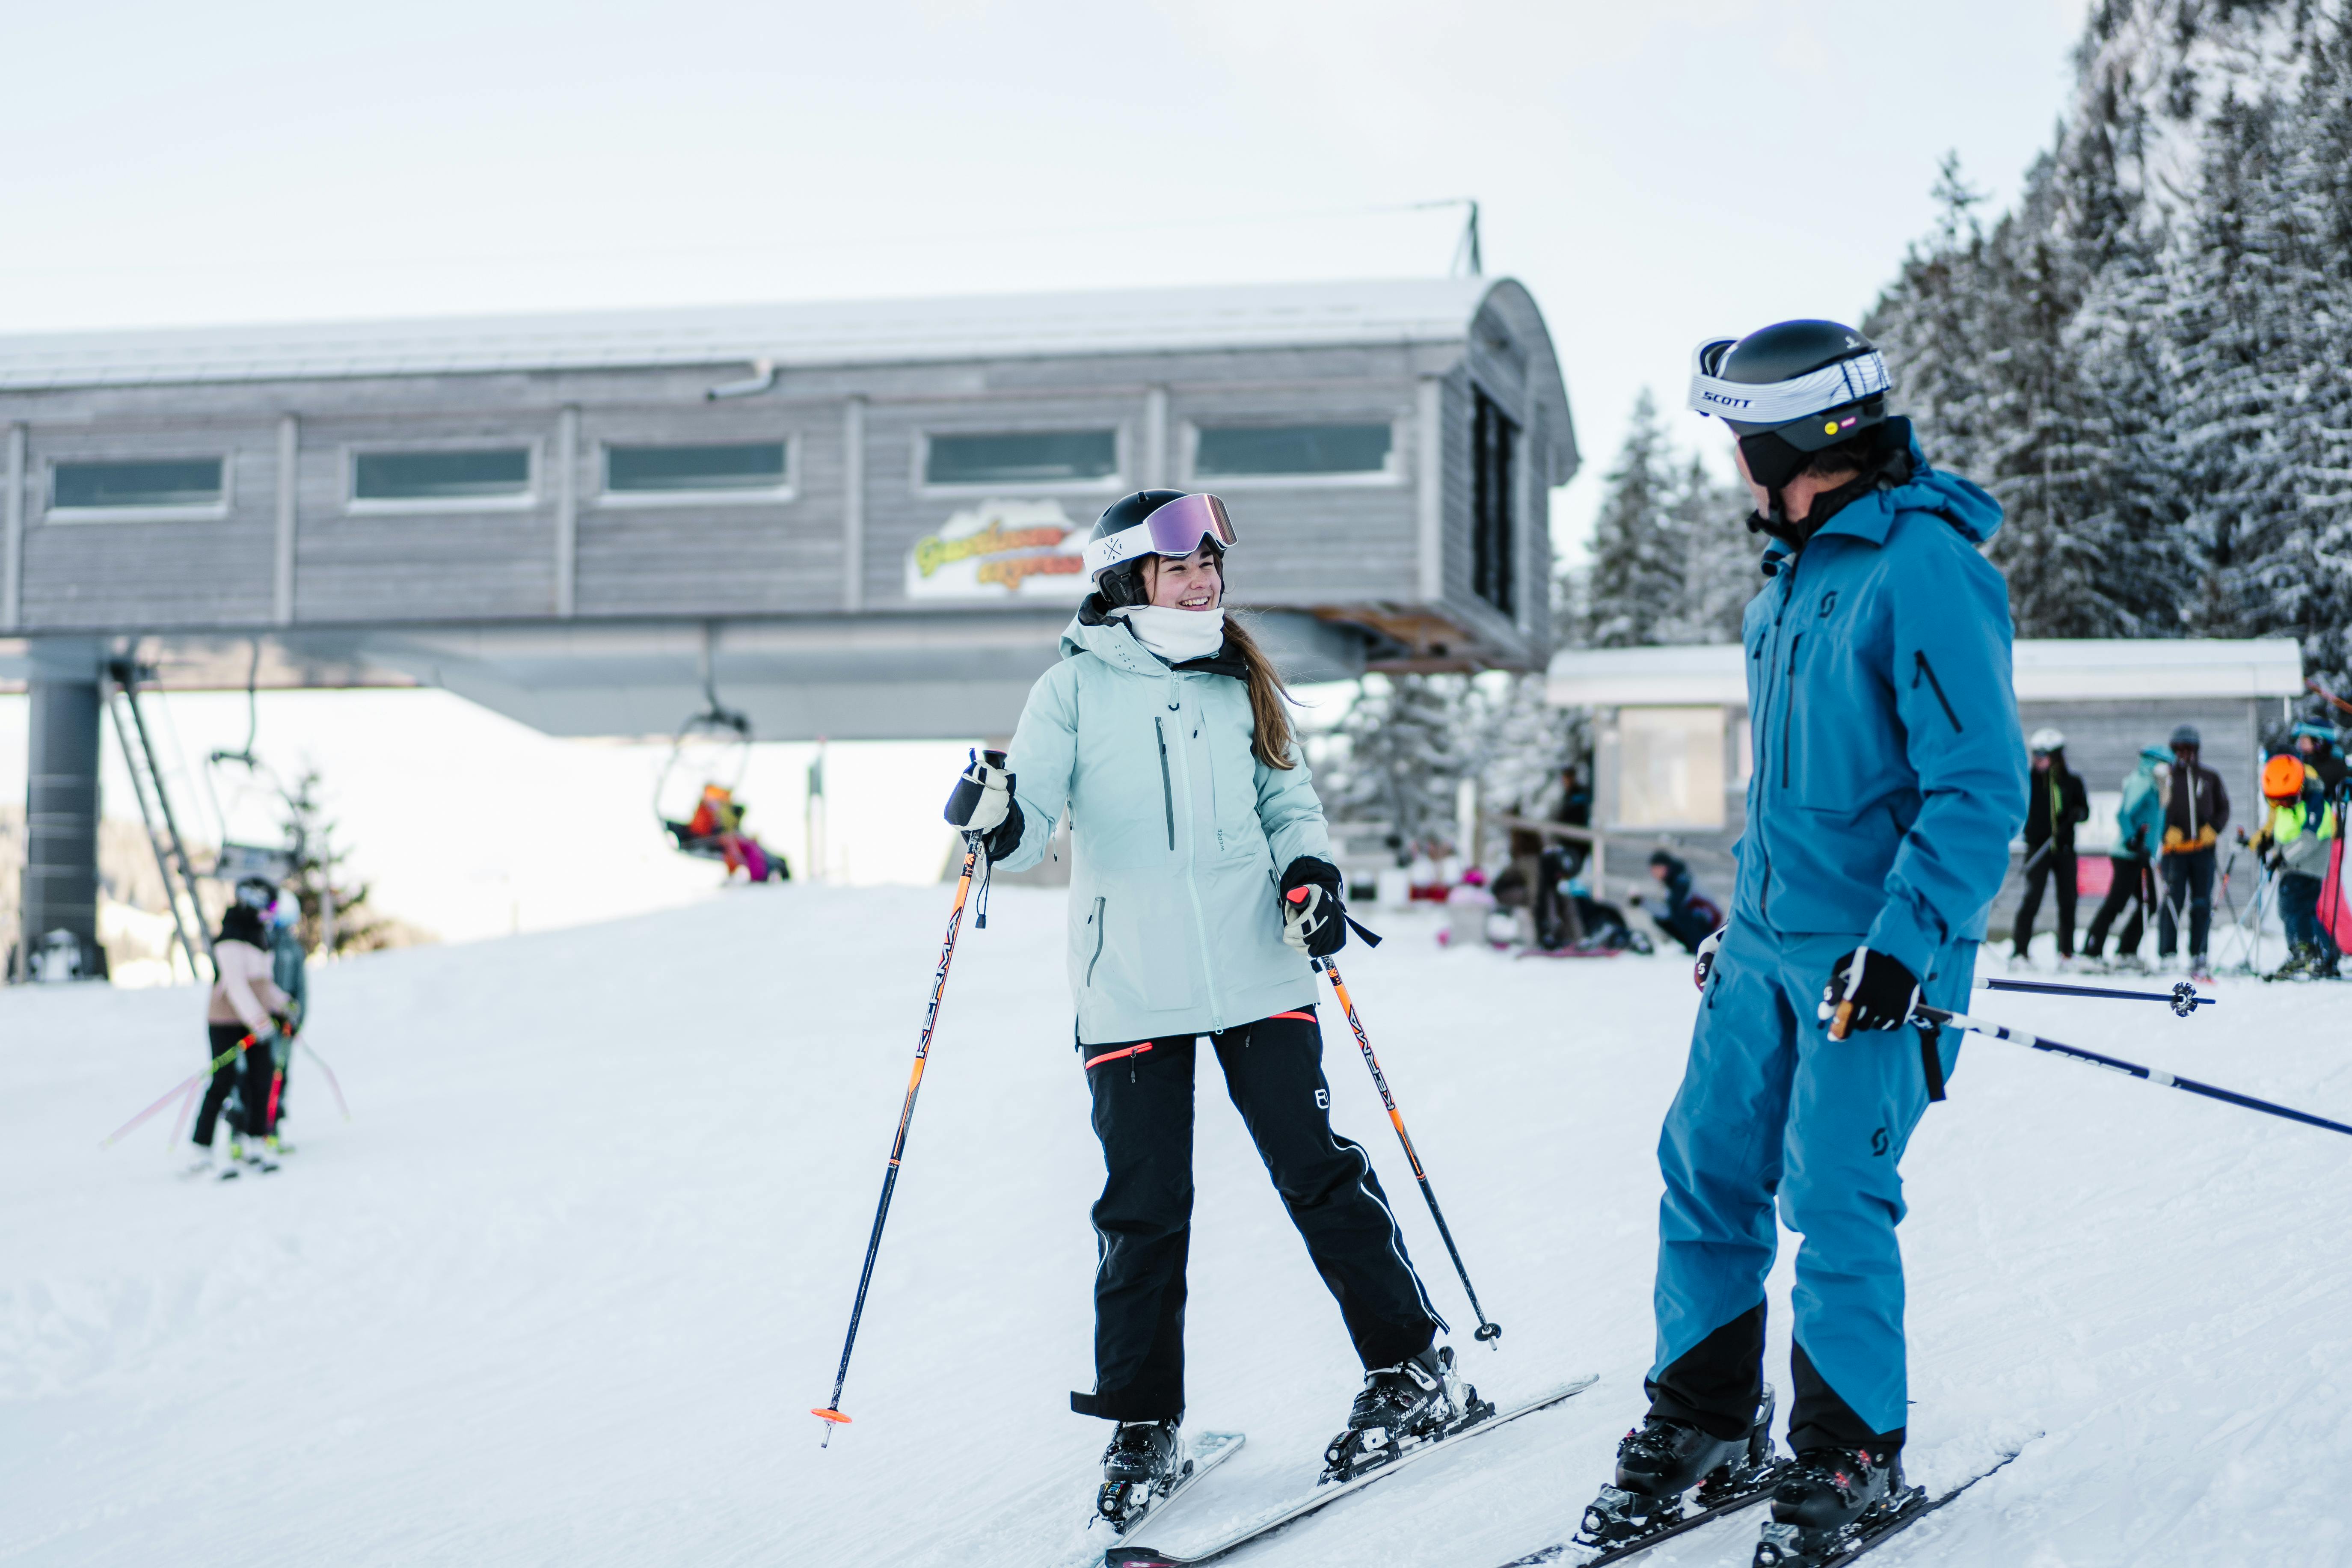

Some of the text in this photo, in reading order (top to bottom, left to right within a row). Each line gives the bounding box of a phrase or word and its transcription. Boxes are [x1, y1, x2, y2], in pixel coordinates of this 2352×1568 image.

[1702, 391, 1753, 408] SCOTT
[916, 907, 962, 1058] KERMA
[1349, 1004, 1395, 1110] KERMA
[1400, 1396, 1428, 1422] SALOMON
